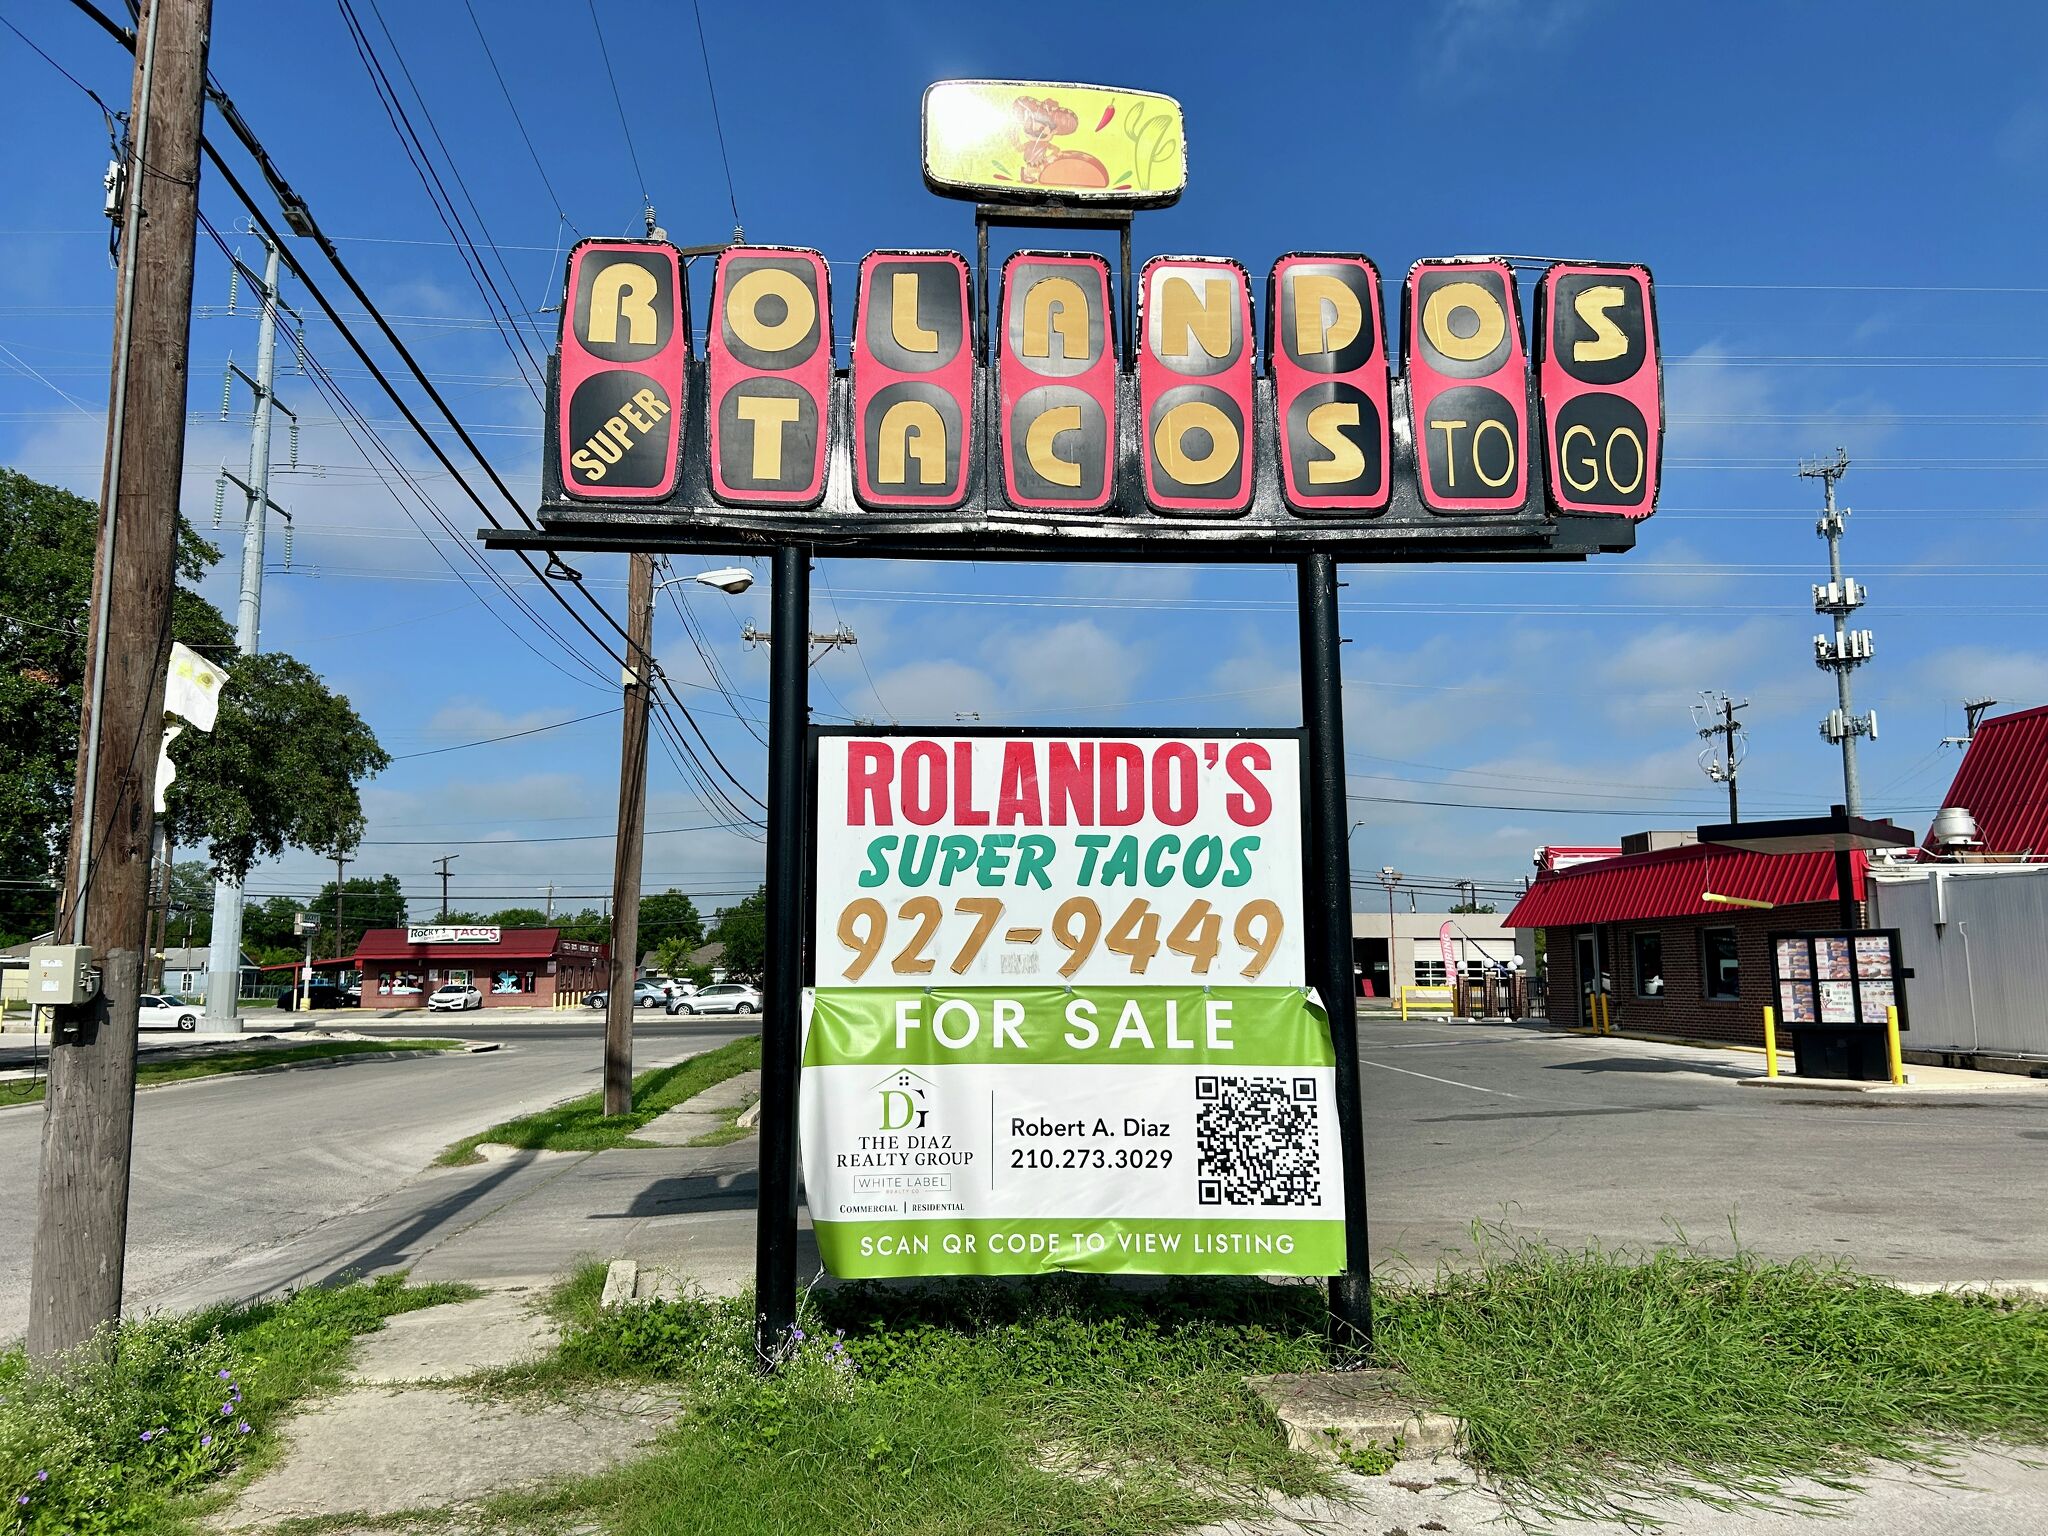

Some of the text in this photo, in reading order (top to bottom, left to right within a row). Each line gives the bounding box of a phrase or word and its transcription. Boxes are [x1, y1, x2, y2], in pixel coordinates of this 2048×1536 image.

[587, 261, 1629, 363] ROLANDOS
[571, 387, 1644, 495] SUPER TACOS TO GO
[846, 740, 1273, 827] ROLANDO'S
[858, 833, 1261, 890] SUPER TACOS
[454, 928, 497, 940] TACOS
[836, 896, 1284, 982] 927-9449
[1443, 932, 1455, 971] HIRING
[896, 999, 1234, 1050] FOR SALE
[1011, 1117, 1171, 1136] Robert A. Diaz
[858, 1135, 952, 1150] THE DIAZ
[837, 1151, 974, 1168] REALTY GROUP
[1011, 1149, 1173, 1169] 210.273.3029
[858, 1176, 947, 1188] WHITE LABEL
[839, 1203, 965, 1213] COMMERCIAL RESIDENTIAL
[860, 1232, 1295, 1256] SCAN QR CODE TO VIEW LISTING
